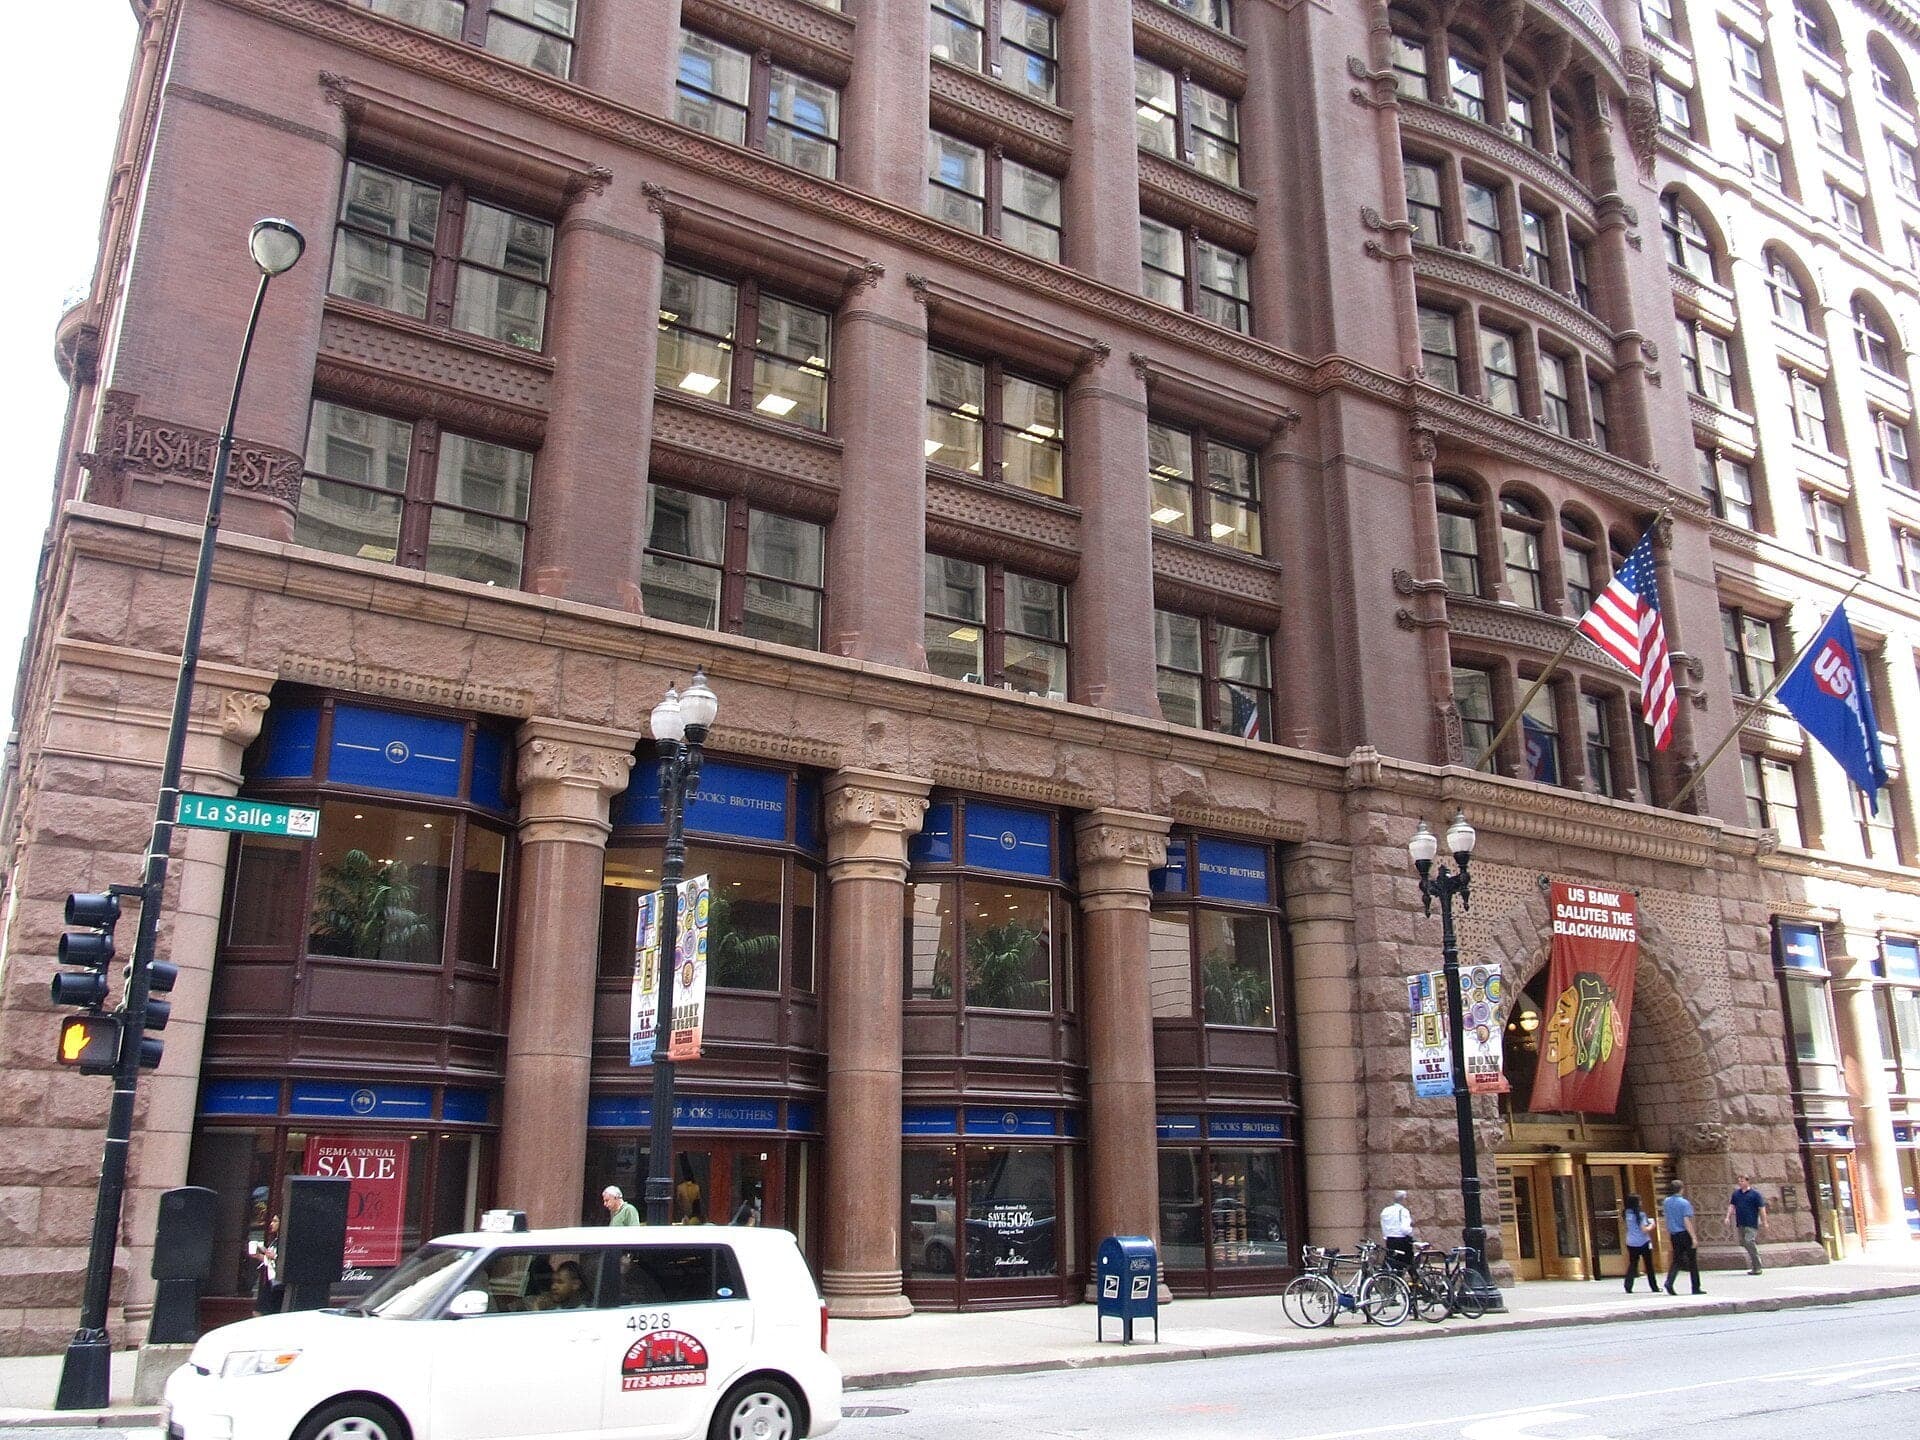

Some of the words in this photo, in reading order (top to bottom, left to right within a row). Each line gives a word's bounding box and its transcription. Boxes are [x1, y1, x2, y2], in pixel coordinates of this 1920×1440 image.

[730, 795, 782, 812] BROTHERS
[184, 803, 192, 814] S
[196, 801, 219, 821] La
[224, 804, 272, 827] Salle
[275, 814, 287, 825] St
[1199, 863, 1227, 875] BROOKS
[1229, 867, 1266, 880] BROTHERS
[1568, 887, 1586, 903] US
[1588, 890, 1621, 908] BANK
[1556, 903, 1609, 923] SALUTES
[1611, 910, 1634, 926] THE
[1553, 920, 1636, 942] BLACKHAWKS
[717, 1108, 774, 1121] BROTHERS
[1211, 1122, 1240, 1132] BROOKS
[1242, 1123, 1280, 1133] BROTHERS
[318, 1147, 396, 1157] SEMI-ANNUAL
[316, 1156, 396, 1180] SALE
[988, 1212, 1006, 1220] SAVE
[1007, 1211, 1034, 1227] 50%
[626, 1312, 672, 1331] 4828
